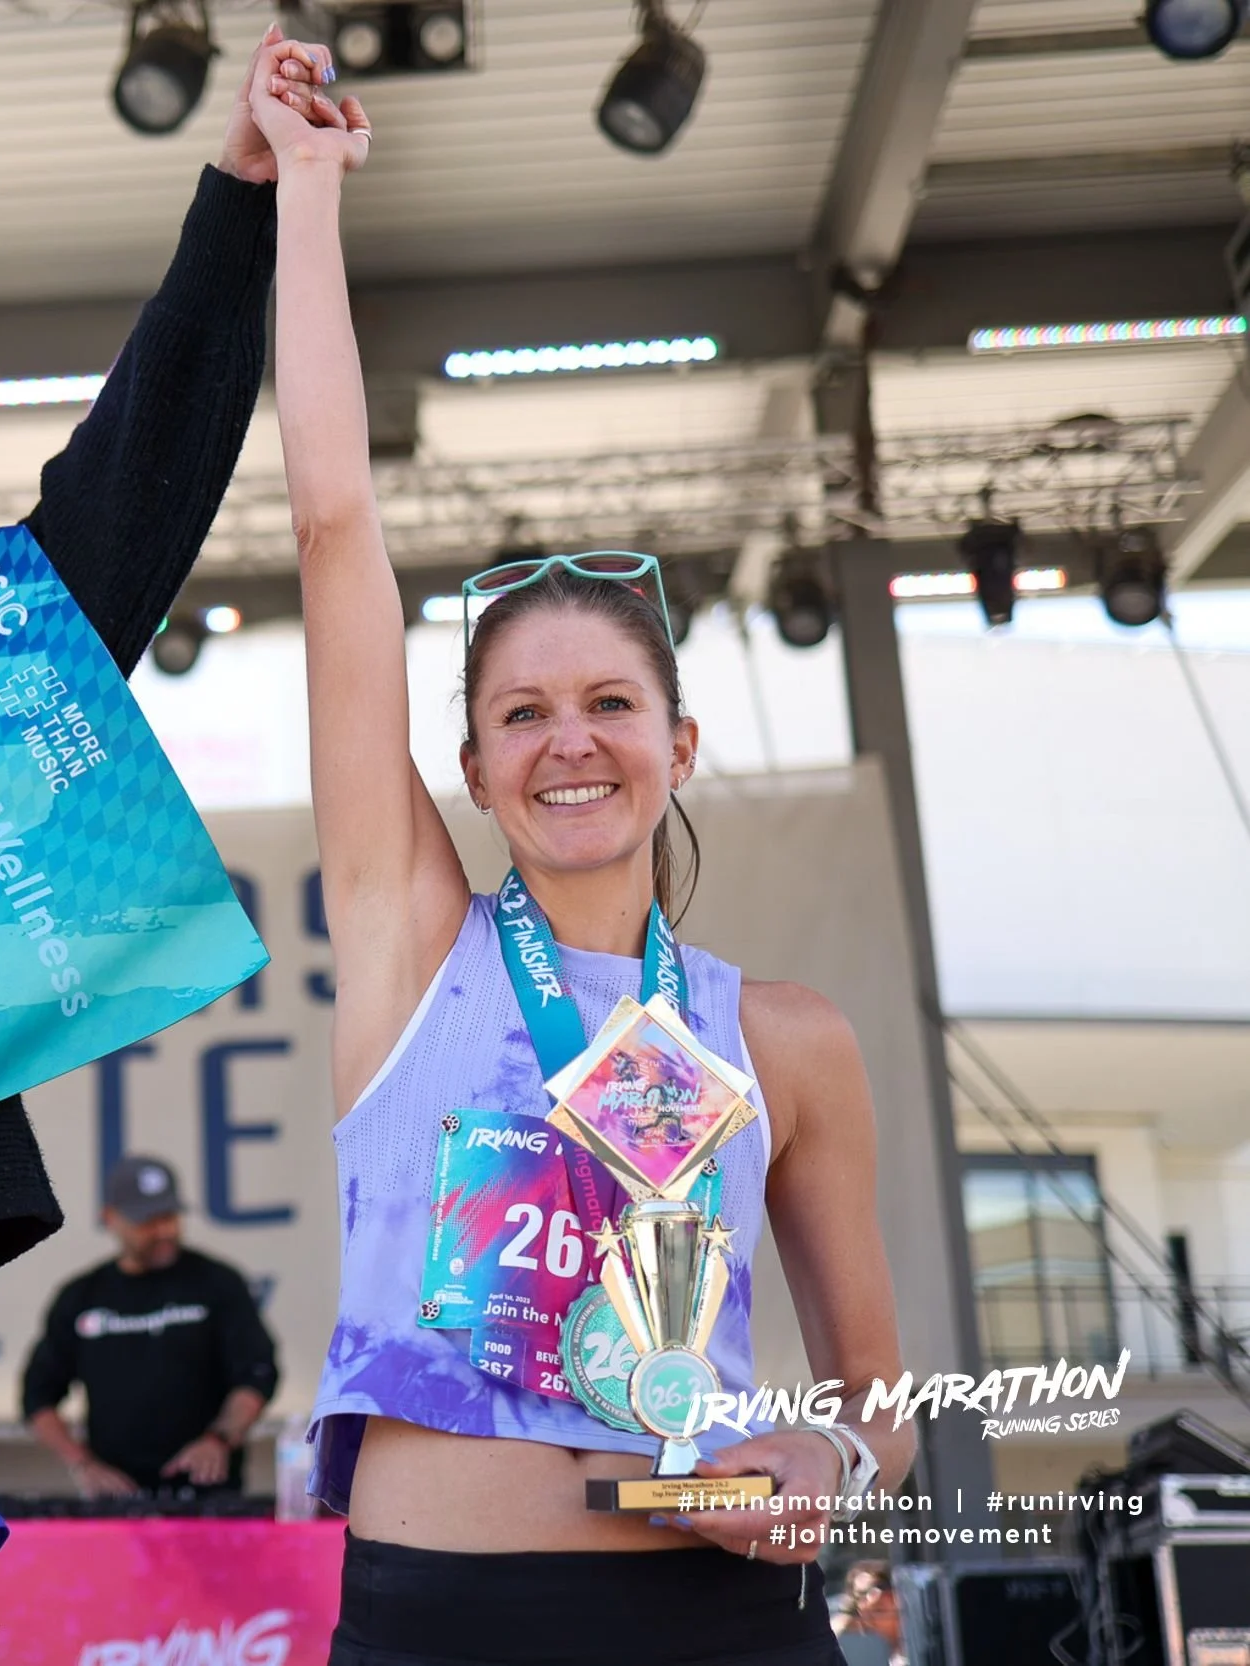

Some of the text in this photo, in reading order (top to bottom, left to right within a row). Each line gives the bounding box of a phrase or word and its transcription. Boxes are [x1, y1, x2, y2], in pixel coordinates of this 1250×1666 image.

[21, 724, 70, 795] MUSIC
[43, 713, 88, 779] THAN
[60, 702, 108, 768] MORE
[503, 915, 563, 1008] FINISHER
[439, 1134, 451, 1177] elebrating
[465, 1125, 550, 1154] IRVING
[498, 1202, 594, 1282] 26
[482, 1301, 517, 1318] Join
[522, 1306, 549, 1324] the
[484, 1341, 512, 1356] FOOD
